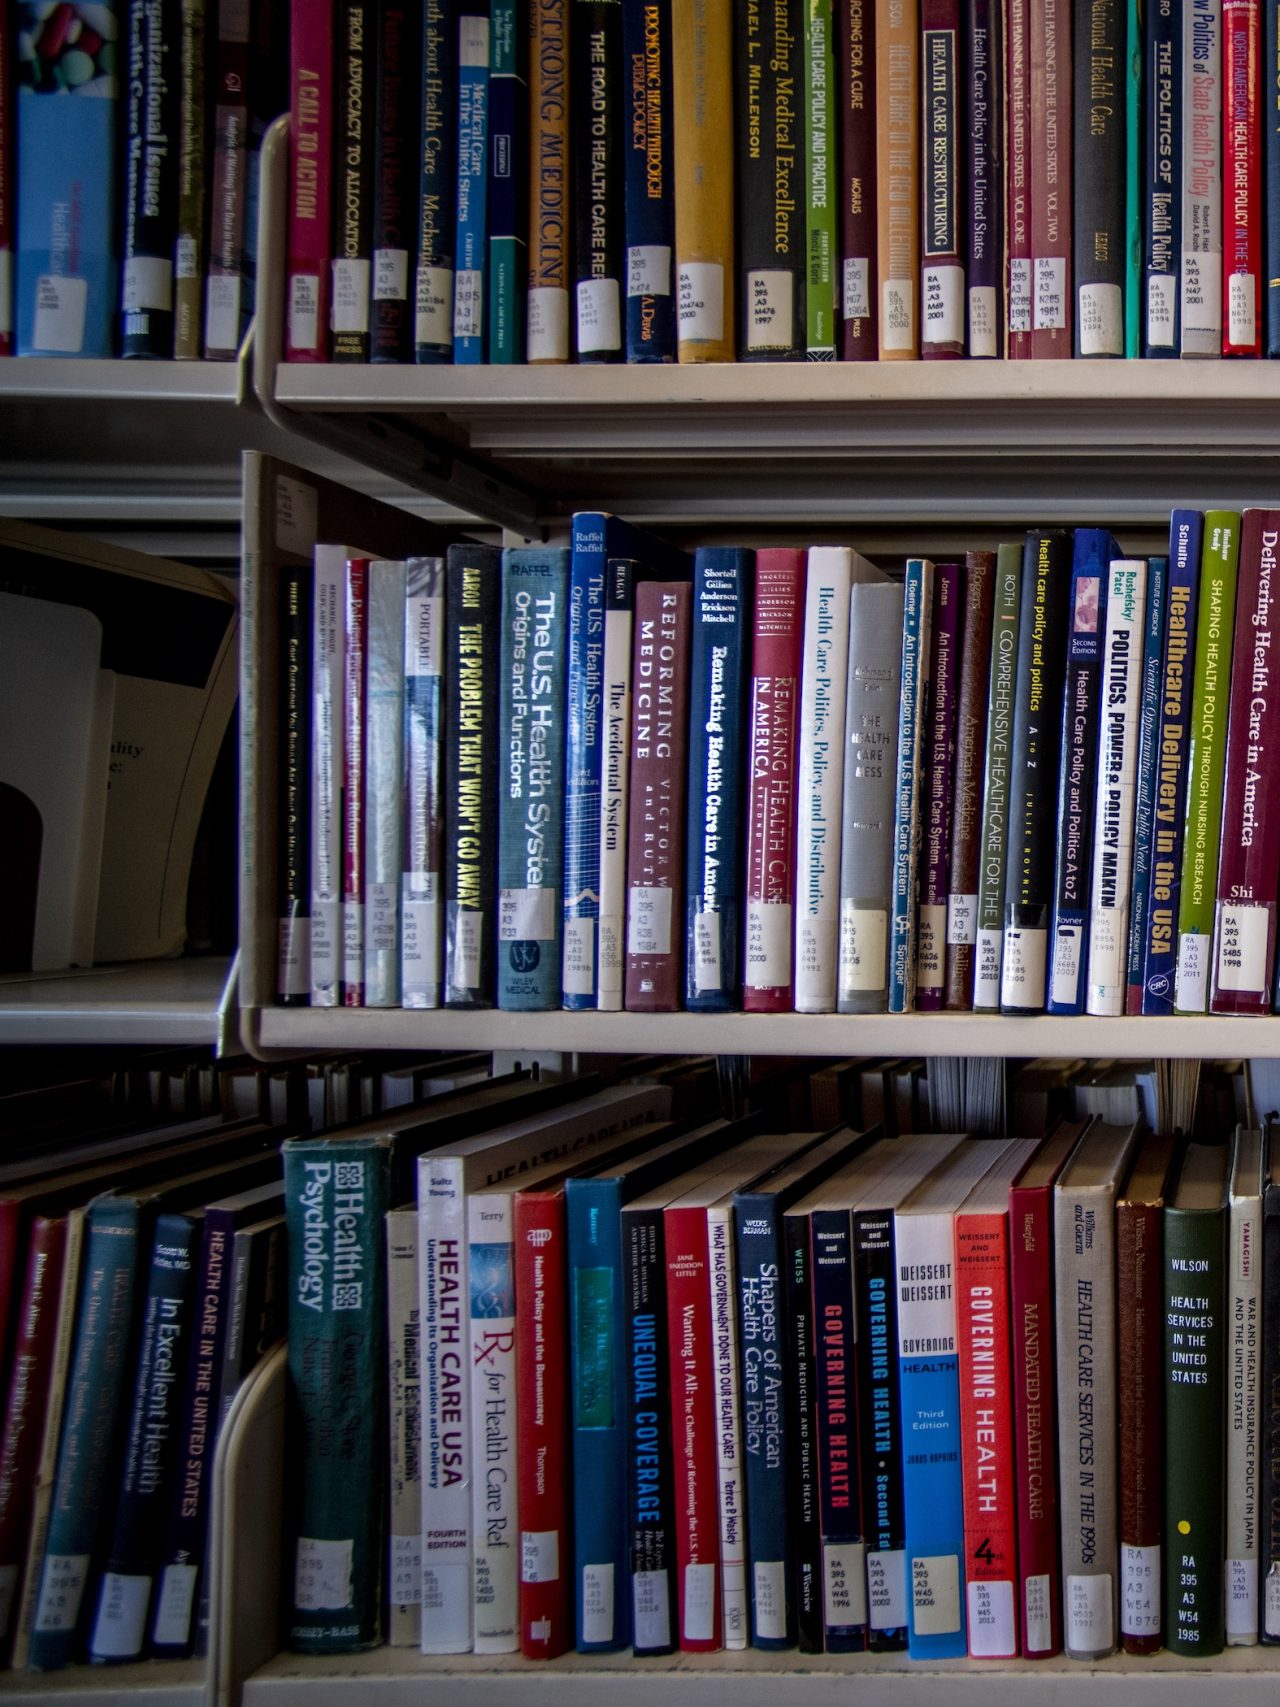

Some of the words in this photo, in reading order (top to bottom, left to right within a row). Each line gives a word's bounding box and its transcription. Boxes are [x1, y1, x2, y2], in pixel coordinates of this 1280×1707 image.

[590, 31, 605, 64] THE
[810, 18, 825, 57] HEALTH
[974, 28, 986, 67] Health
[298, 69, 319, 81] A
[811, 60, 826, 88] CARE
[933, 38, 946, 91] HEALTH
[1160, 41, 1171, 75] THE
[591, 67, 605, 111] ROAD
[974, 71, 986, 99] Care
[297, 86, 319, 126] CALL
[592, 114, 605, 136] TO
[812, 91, 826, 128] POLICY
[933, 96, 946, 133] CARE
[971, 102, 986, 138] Policy
[1160, 79, 1172, 156] POLITICS
[297, 132, 318, 152] TO
[813, 131, 826, 154] AND
[974, 143, 986, 151] in
[591, 140, 605, 200] HEALTH
[813, 157, 826, 208] PRACTICE
[974, 156, 986, 176] the
[1160, 161, 1172, 183] OF
[295, 158, 317, 219] ACTION
[933, 137, 947, 246] RESTRUCTURING
[974, 179, 986, 219] United
[591, 204, 605, 248] CARE
[1152, 192, 1172, 232] Health
[974, 222, 986, 259] States
[1148, 235, 1171, 272] Policy
[1176, 524, 1190, 568] Schulte
[462, 568, 481, 608] AARON
[1252, 530, 1277, 626] Delivering
[458, 624, 482, 653] THE
[1168, 586, 1190, 719] Healthcare
[1251, 631, 1272, 693] Health
[459, 658, 482, 730] PROBLEM
[608, 682, 625, 708] The
[1249, 698, 1267, 739] Care
[458, 734, 482, 775] THAT
[607, 714, 624, 793] Accidental
[1247, 744, 1263, 761] in
[1156, 725, 1184, 822] Delivery
[605, 797, 622, 851] System
[1241, 766, 1261, 846] America
[458, 837, 482, 859] GO
[1158, 830, 1178, 851] in
[457, 863, 481, 907] AWAY
[1153, 863, 1176, 901] the
[1151, 909, 1172, 954] USA
[298, 1161, 330, 1312] Psychology
[333, 1192, 362, 1281] Health
[428, 1239, 436, 1322] Understanding
[1171, 1260, 1210, 1272] WILSON
[439, 1240, 460, 1344] HEALTH
[1076, 1280, 1093, 1340] HEALTH
[1170, 1296, 1210, 1309] HEALTH
[1167, 1315, 1213, 1327] SERVICES
[1172, 1334, 1186, 1346] IN
[1188, 1334, 1207, 1347] THE
[633, 1313, 657, 1404] UNEQUAL
[969, 1286, 994, 1398] GOVERNING
[1171, 1351, 1208, 1364] UNITED
[428, 1344, 438, 1413] Organization
[1077, 1344, 1094, 1388] CARE
[1171, 1370, 1208, 1383] STATES
[440, 1352, 461, 1426] CARE
[428, 1417, 438, 1438] and
[1078, 1393, 1094, 1465] SERVICES
[428, 1442, 438, 1489] Delivery
[441, 1433, 462, 1487] USA
[635, 1411, 662, 1524] COVERAGE
[976, 1410, 996, 1512] HEALTH
[1079, 1471, 1094, 1487] IN
[1079, 1492, 1094, 1525] THE
[1078, 1526, 1096, 1564] 1990s
[1182, 1556, 1195, 1567] RA
[1181, 1574, 1197, 1586] 395
[1182, 1593, 1195, 1604] A3
[1178, 1610, 1199, 1622] W54
[1178, 1629, 1200, 1641] 1985
